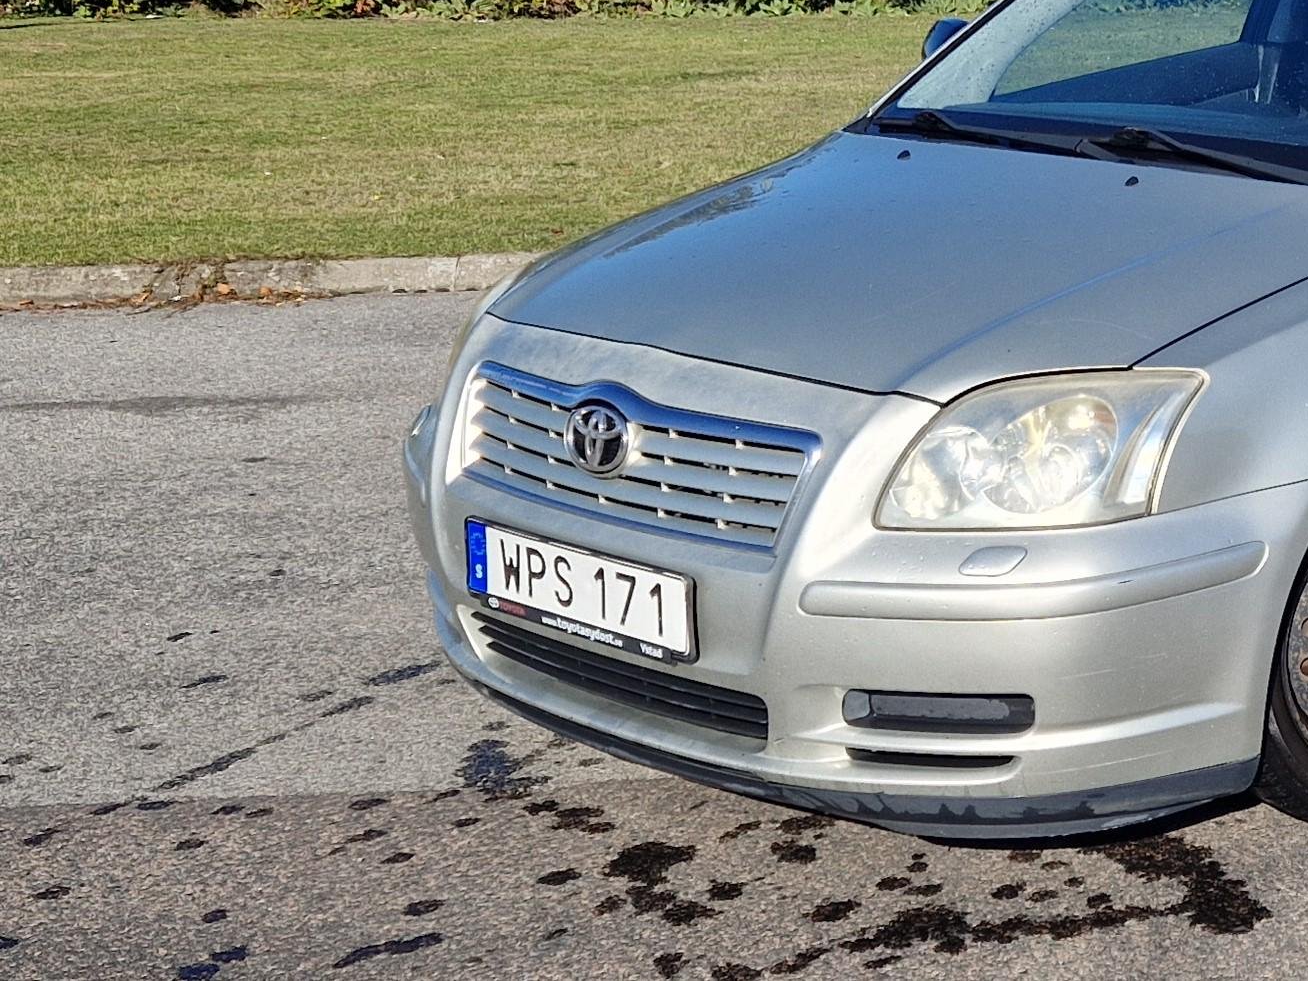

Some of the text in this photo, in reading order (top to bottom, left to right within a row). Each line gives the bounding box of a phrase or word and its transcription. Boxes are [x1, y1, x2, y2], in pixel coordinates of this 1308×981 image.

[475, 563, 483, 579] S
[499, 538, 663, 638] WPS 171
[499, 601, 527, 616] TOYOTA
[640, 642, 663, 659] Ystad
